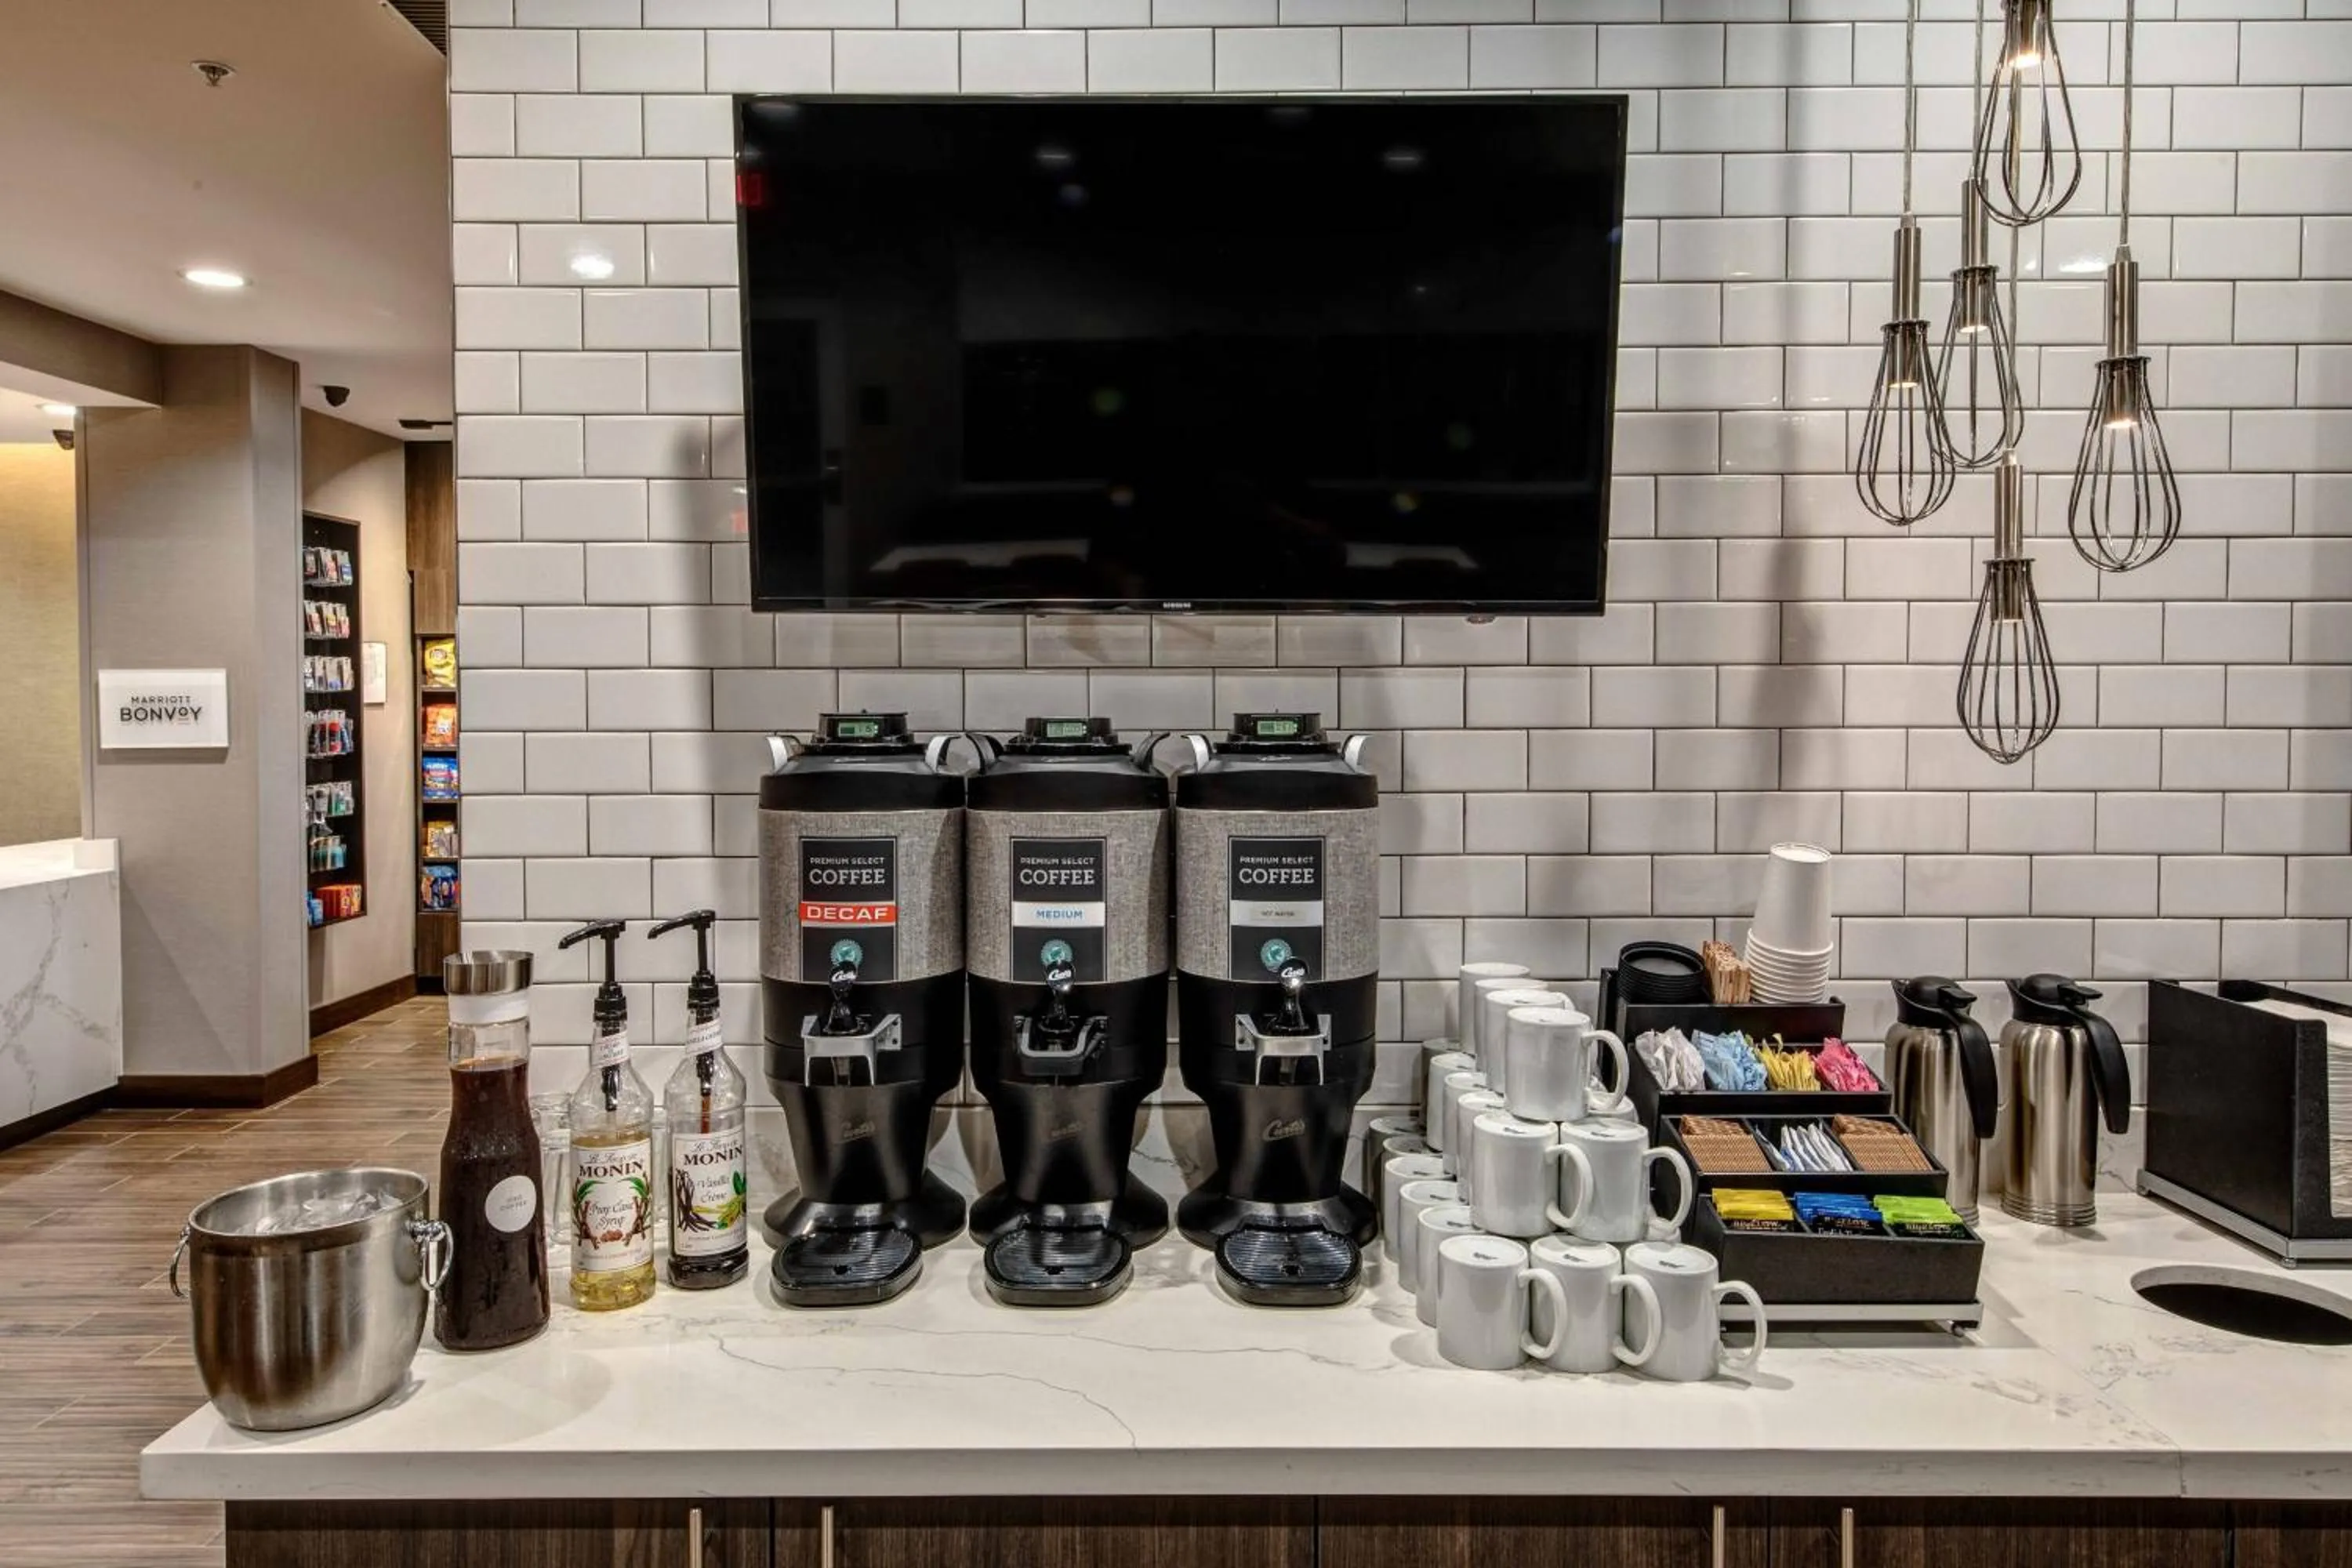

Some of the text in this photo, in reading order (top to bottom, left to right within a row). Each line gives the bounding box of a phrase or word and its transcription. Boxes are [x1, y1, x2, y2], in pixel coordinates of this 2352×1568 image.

[131, 695, 191, 704] MARRIOTT
[120, 707, 201, 721] BONVOY
[1240, 856, 1314, 865] PREMIUM SELECT
[809, 868, 885, 885] COFFEE
[1019, 869, 1094, 885] COFFEE
[1239, 868, 1315, 884] COFFEE
[807, 906, 887, 920] DECAF
[1036, 909, 1083, 920] MEDIUM
[683, 1144, 743, 1166] MONIN
[579, 1161, 644, 1177] MONIN
